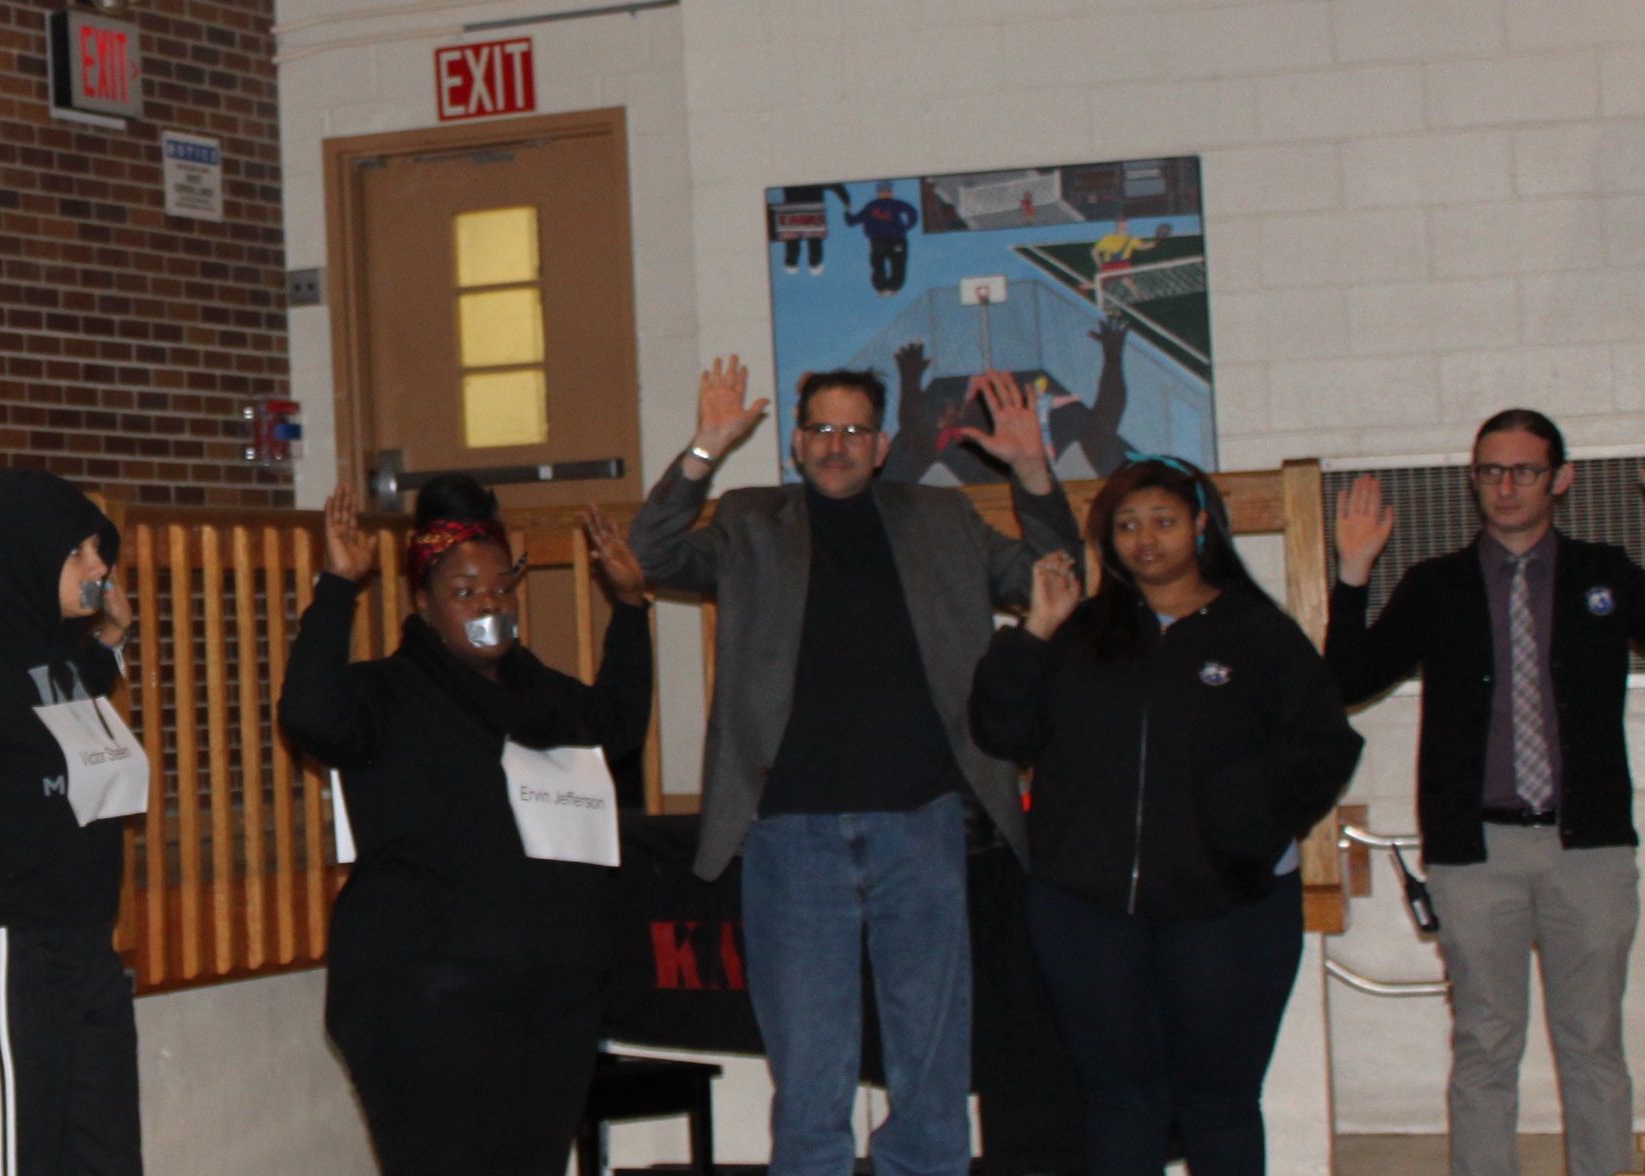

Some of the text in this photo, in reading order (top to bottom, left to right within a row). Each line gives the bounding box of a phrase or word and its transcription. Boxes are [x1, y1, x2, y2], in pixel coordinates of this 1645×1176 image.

[79, 25, 128, 102] EXIT
[439, 42, 529, 117] EXIT
[520, 785, 605, 809] Ervin Jefferson
